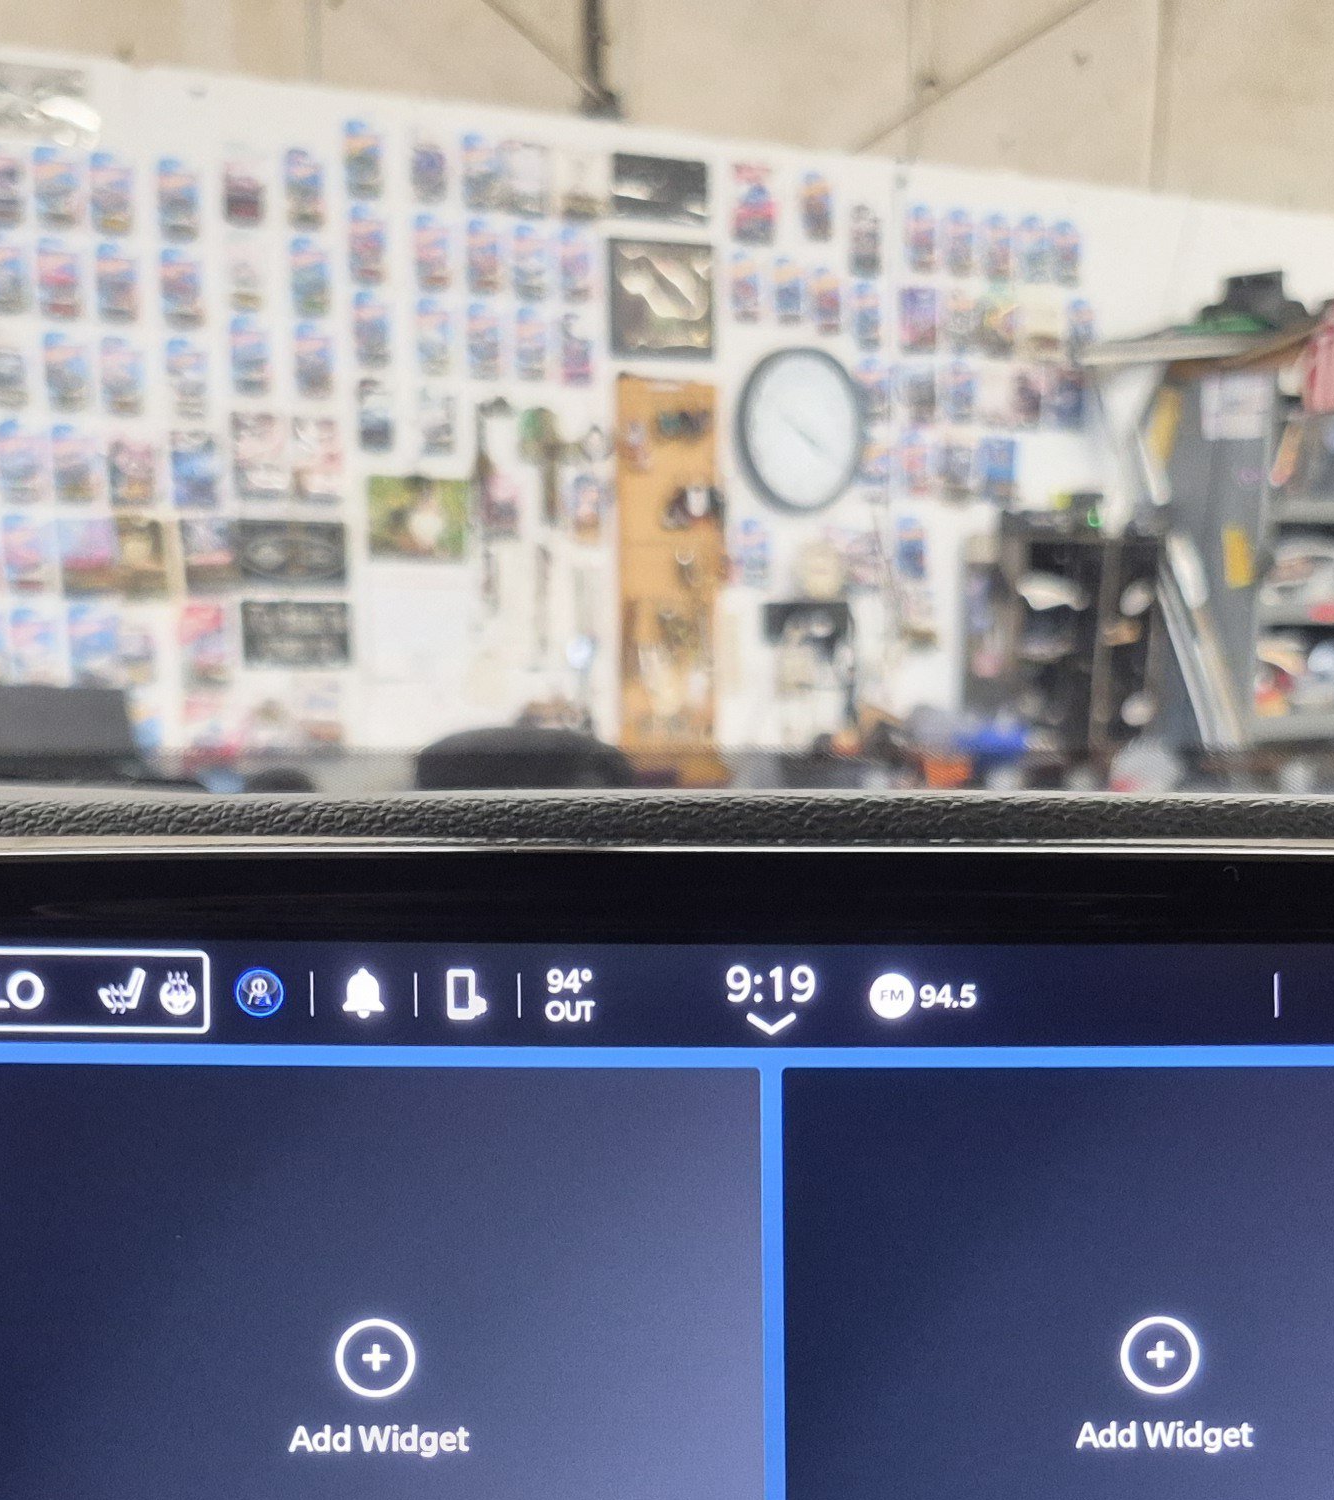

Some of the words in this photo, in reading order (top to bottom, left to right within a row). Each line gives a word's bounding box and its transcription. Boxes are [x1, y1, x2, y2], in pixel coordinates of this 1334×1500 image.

[546, 968, 593, 994] 94°
[725, 964, 816, 1003] 9:19
[919, 983, 977, 1009] 94.5
[544, 1000, 596, 1023] OUT
[288, 1424, 352, 1453] Add
[357, 1424, 470, 1458] Widget
[1075, 1420, 1137, 1449] Add
[1142, 1420, 1254, 1454] Widget
